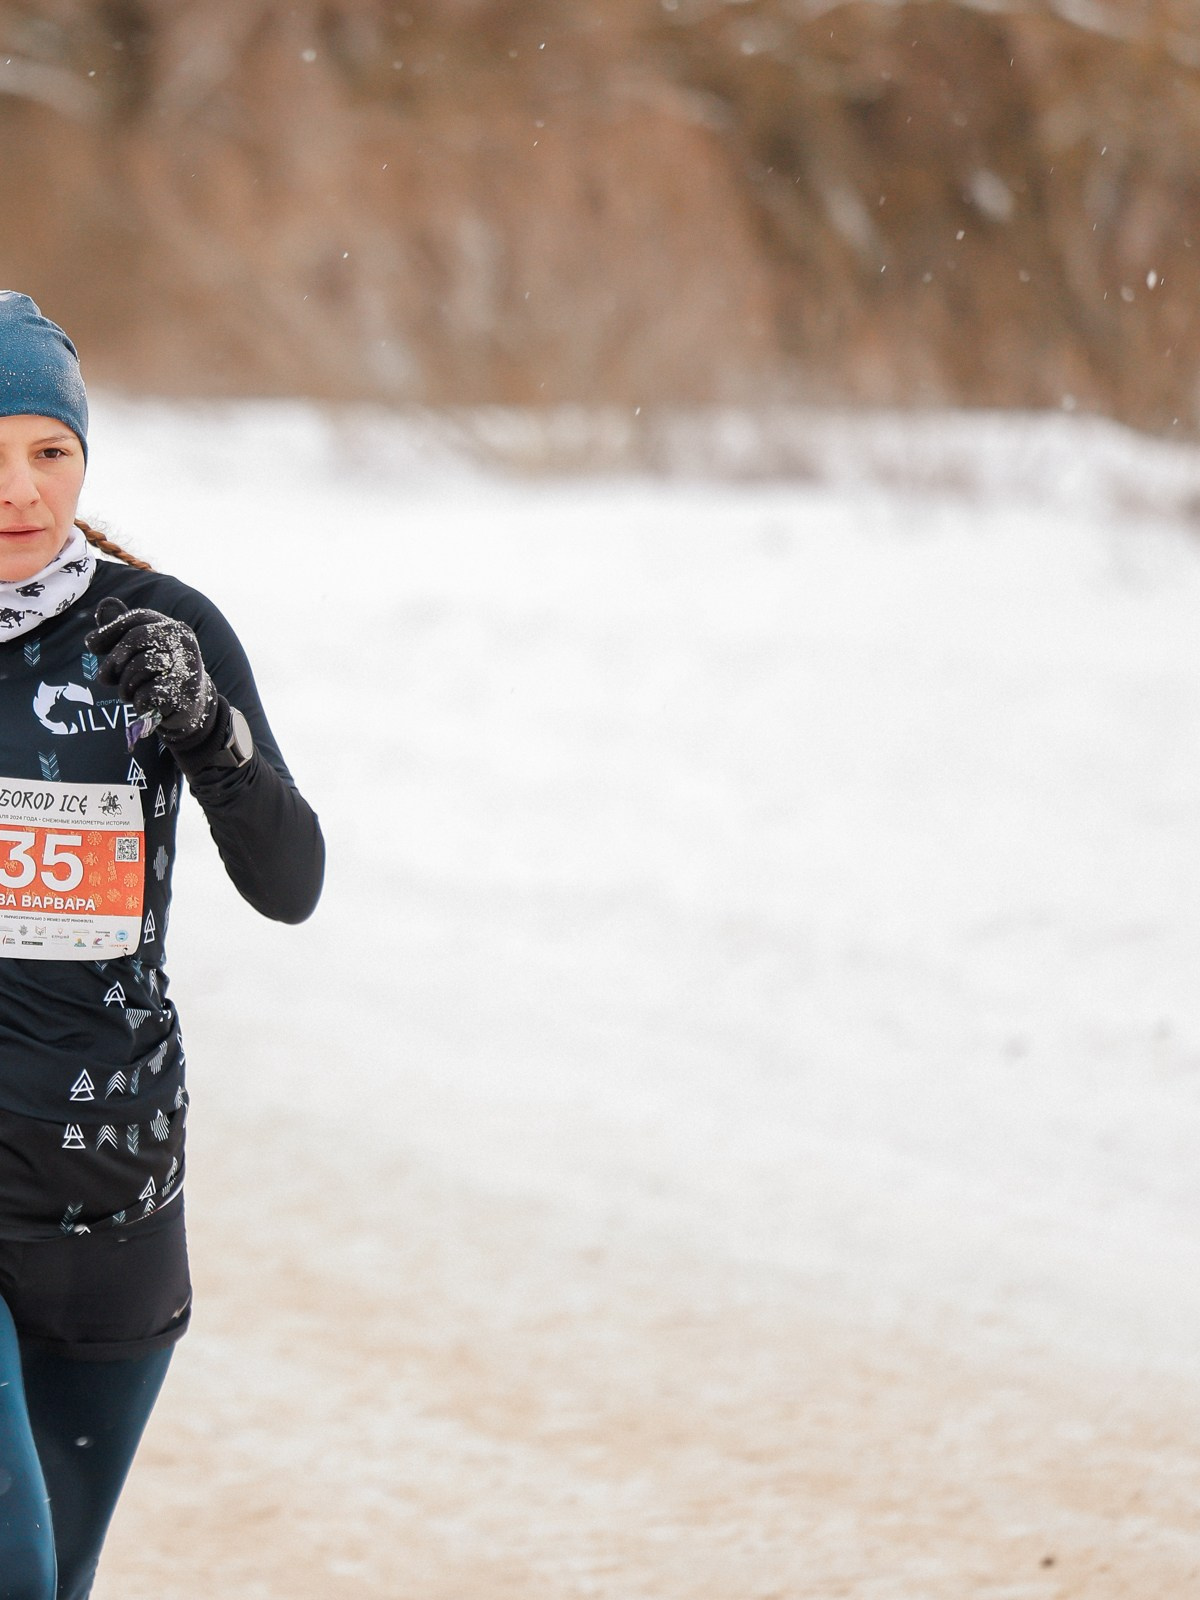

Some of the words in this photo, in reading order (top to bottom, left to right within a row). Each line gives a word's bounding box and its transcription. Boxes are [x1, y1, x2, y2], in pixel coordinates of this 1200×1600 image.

[96, 698, 124, 707] СПОРТИ
[59, 794, 88, 816] ICE
[21, 893, 96, 911] ВАРВАРА
